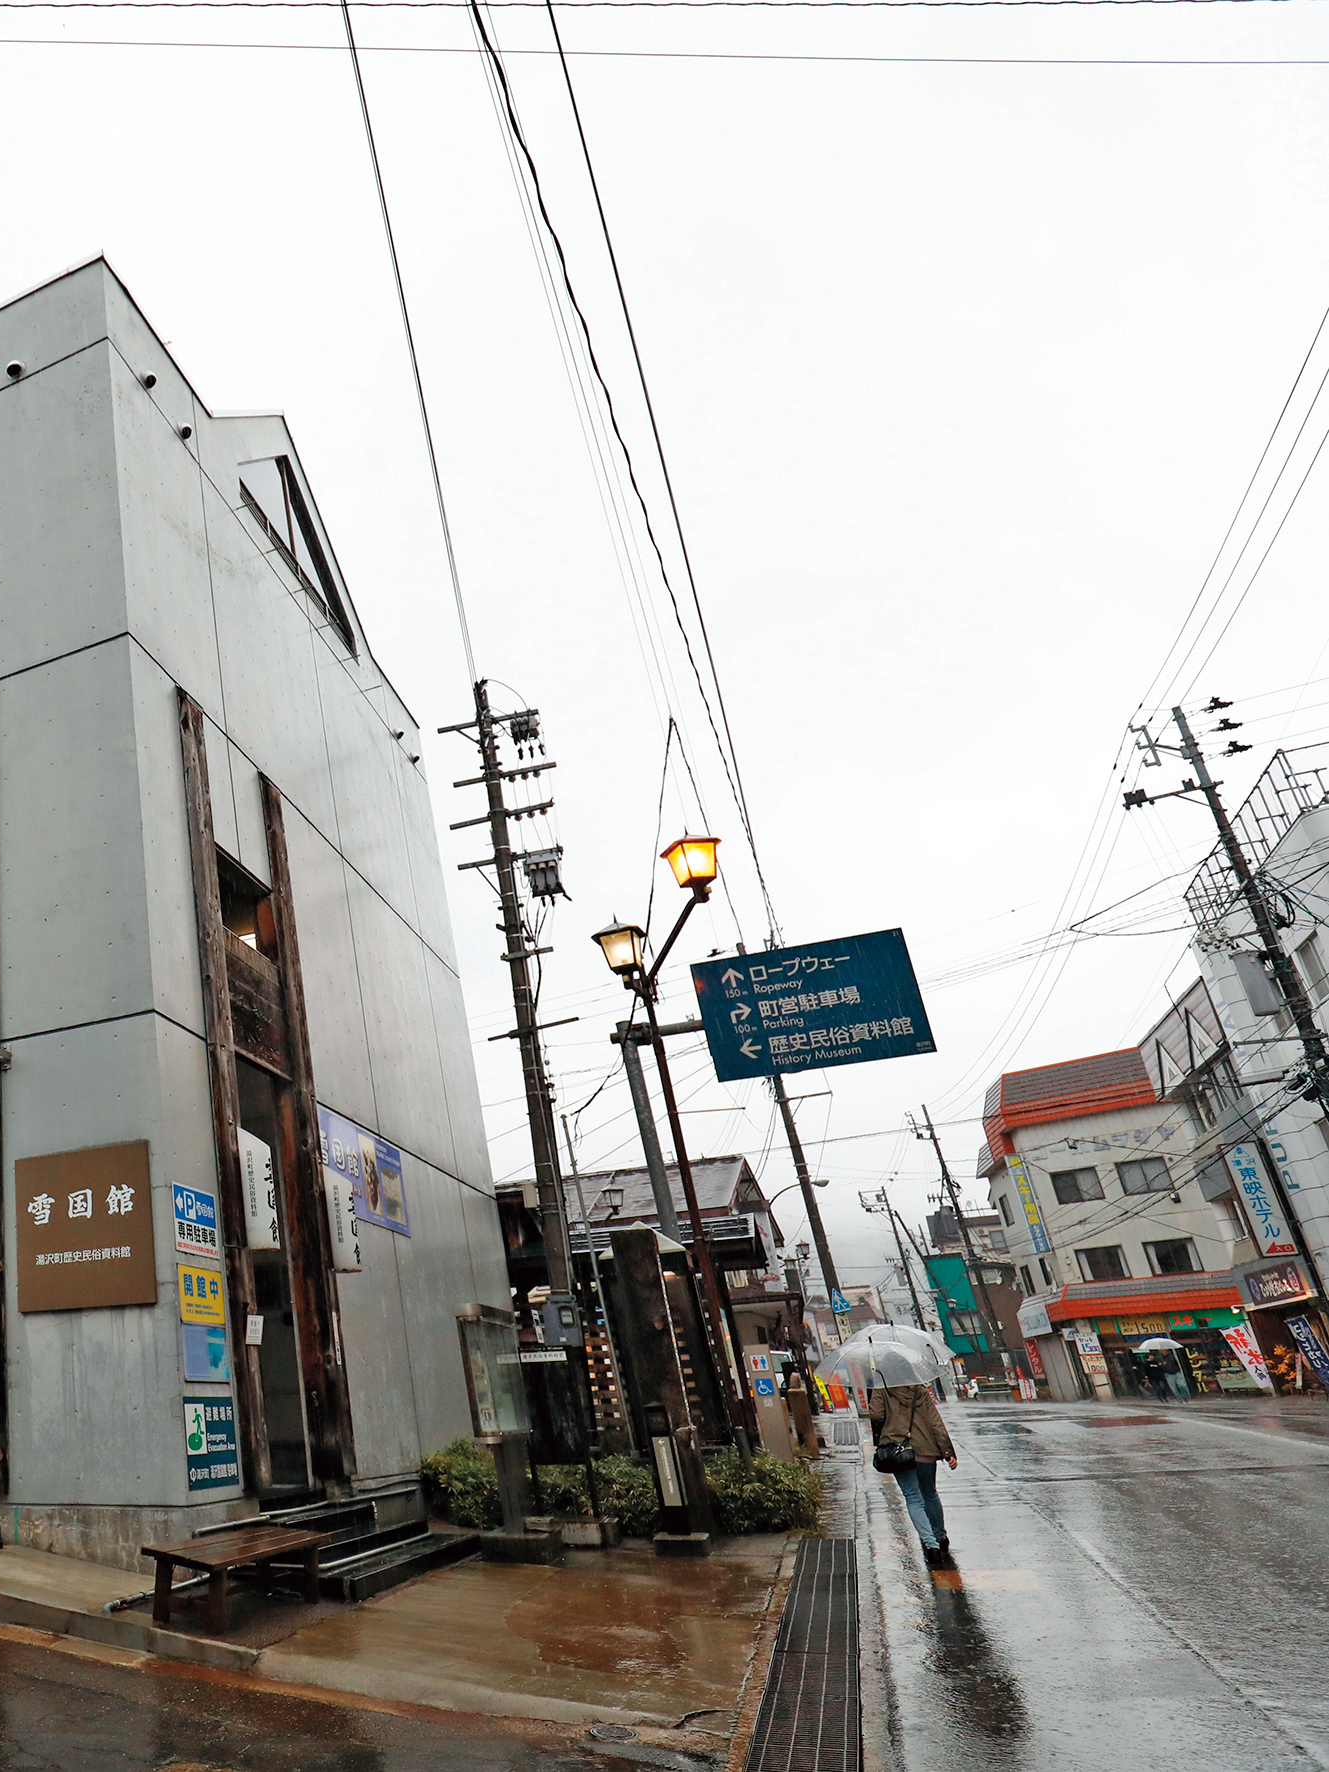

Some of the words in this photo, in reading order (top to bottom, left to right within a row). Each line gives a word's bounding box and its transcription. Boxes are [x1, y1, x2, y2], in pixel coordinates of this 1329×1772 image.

[749, 955, 850, 982] ロープウェー
[753, 978, 803, 995] Ropeway
[758, 985, 861, 1018] 町営駐車場
[762, 1016, 804, 1030] Parking
[768, 1016, 914, 1054] 歴史民俗資料館
[772, 1050, 812, 1066] History
[815, 1045, 862, 1060] Museum
[27, 1184, 135, 1225] 雪国館
[185, 1193, 194, 1216] P
[1237, 1167, 1280, 1238] 東映ホテル
[178, 1221, 216, 1247] 専用駐車場
[35, 1246, 131, 1266] 湯沢町歴史民俗資料館
[183, 1273, 219, 1300] 開館中
[1171, 1314, 1212, 1327] スキー
[1025, 1340, 1043, 1374] レンタル
[1185, 1348, 1209, 1392] レンタル
[207, 1433, 227, 1443] Emergency
